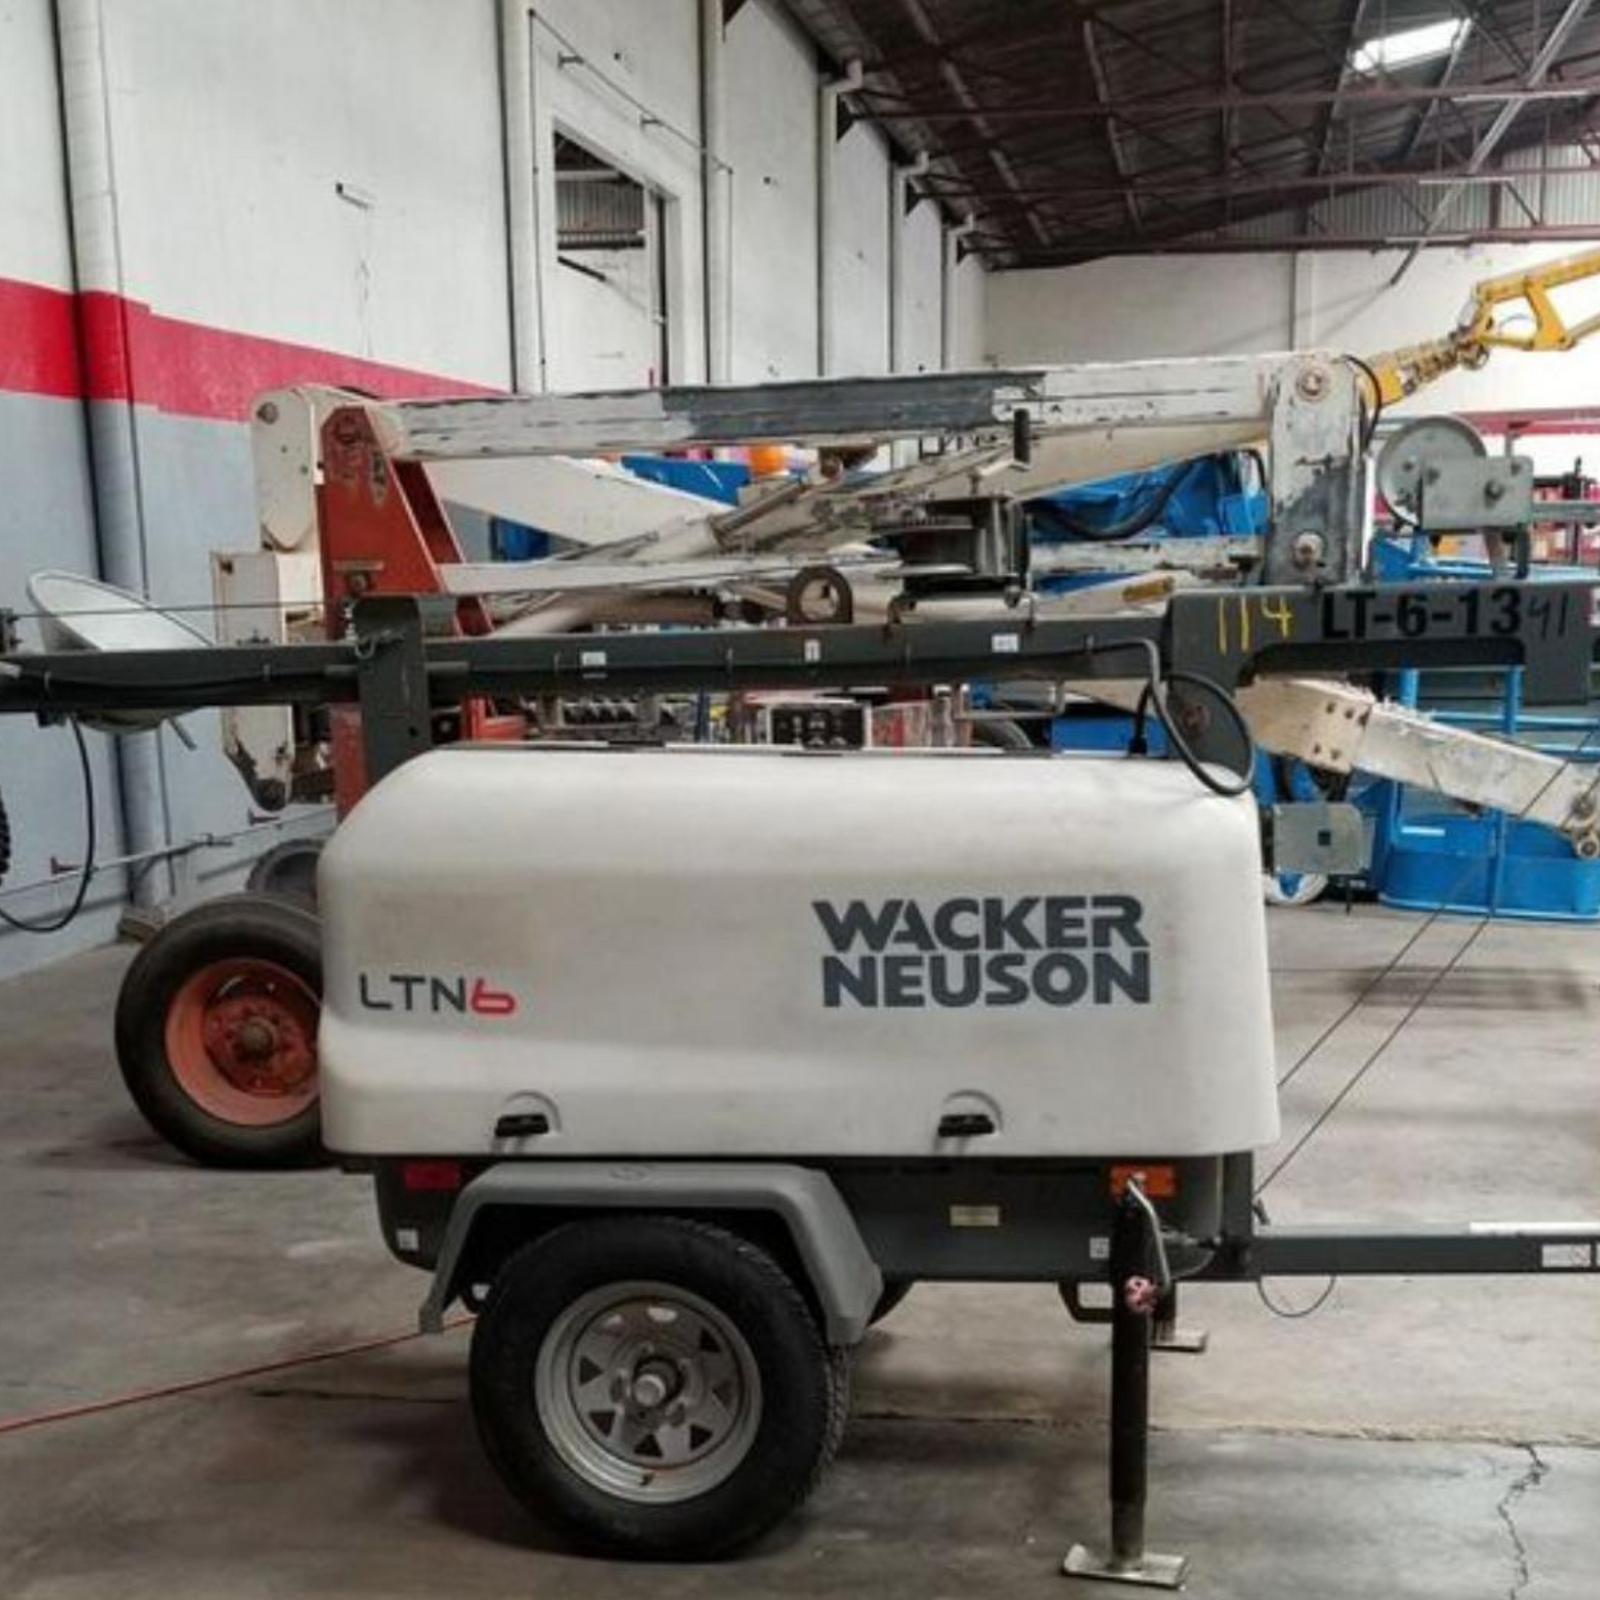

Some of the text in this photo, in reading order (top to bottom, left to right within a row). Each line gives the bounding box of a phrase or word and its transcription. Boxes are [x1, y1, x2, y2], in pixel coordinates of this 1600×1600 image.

[1219, 595, 1293, 655] 114
[811, 894, 1151, 953] WACKER
[359, 972, 516, 1015] LTN6
[822, 951, 1151, 1007] NEUSON
